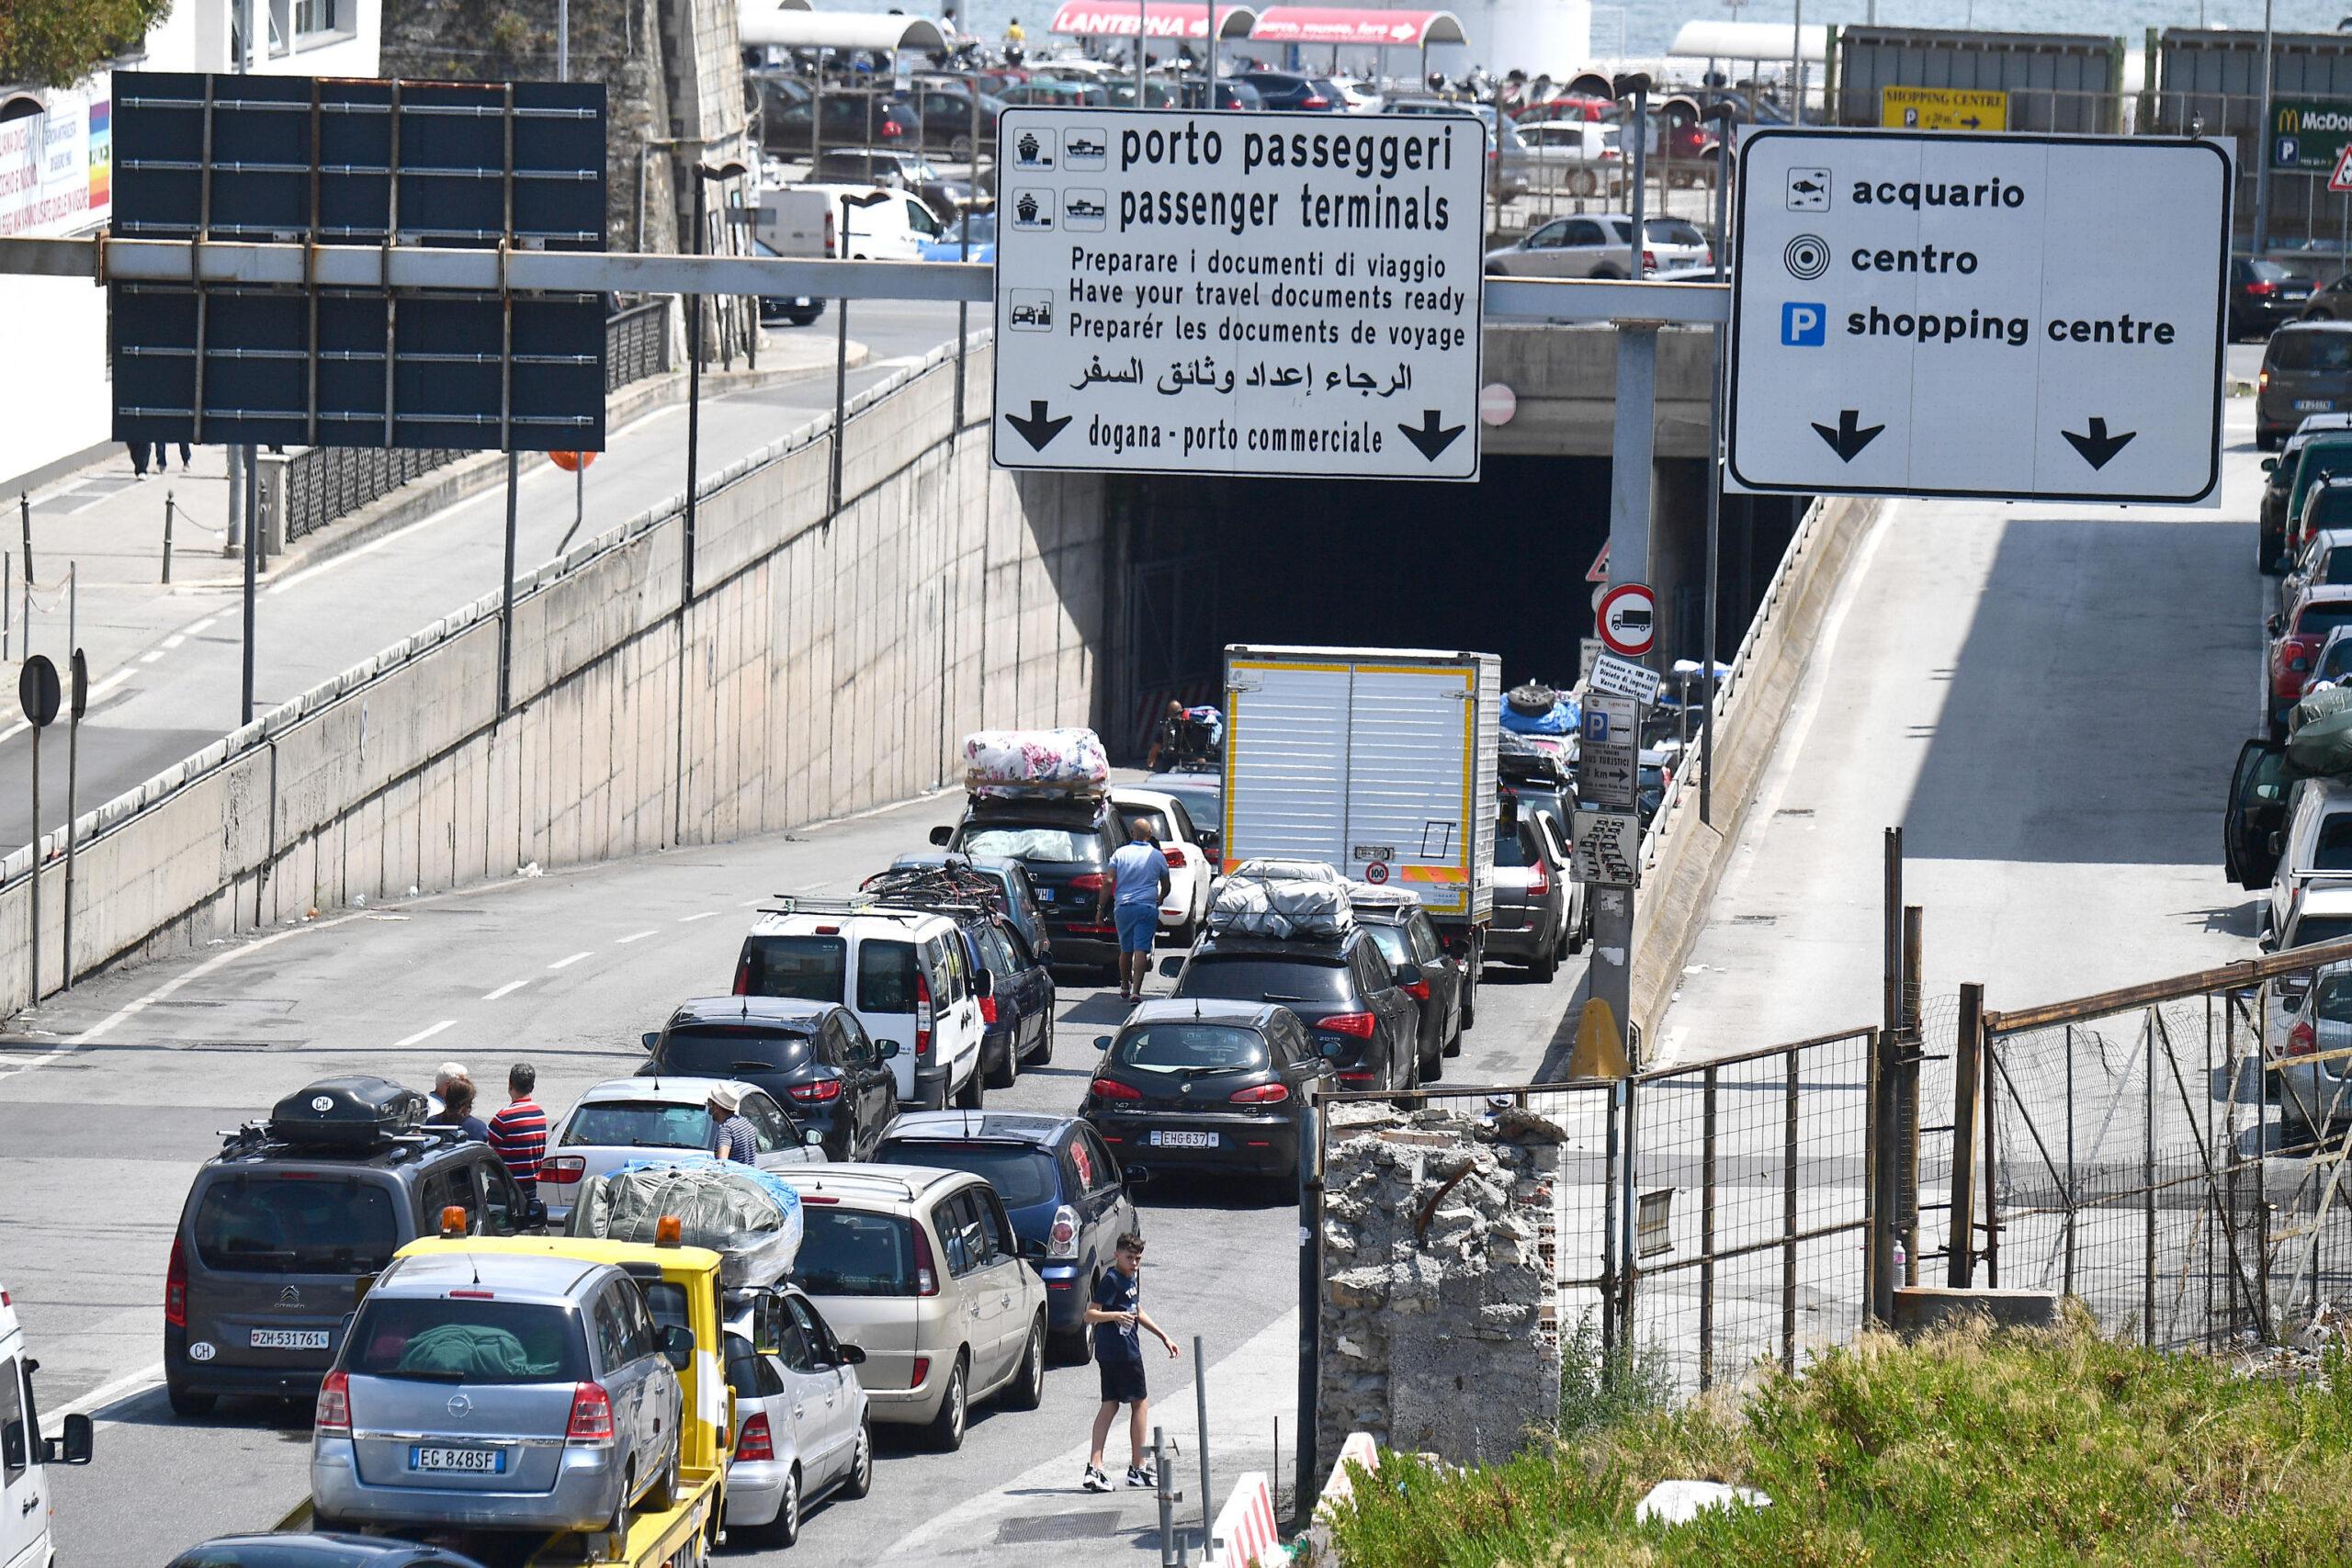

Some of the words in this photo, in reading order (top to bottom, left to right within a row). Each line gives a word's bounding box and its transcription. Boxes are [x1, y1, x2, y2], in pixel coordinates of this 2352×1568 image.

[1887, 90, 1949, 105] SHOPPING
[1954, 94, 2001, 107] CENTRE
[1122, 120, 1222, 172] porto
[1245, 125, 1452, 179] passeggeri
[1121, 191, 1278, 235] passenger
[1301, 183, 1448, 231] terminals
[1853, 177, 2024, 210] acquario
[1072, 247, 1177, 276] Preparare
[1192, 249, 1194, 273] i
[1208, 249, 1322, 276] documenti
[1336, 252, 1354, 276] di
[1368, 253, 1445, 283] viaggio
[1851, 244, 1977, 275] centro
[1070, 278, 1123, 303] Have
[1136, 286, 1182, 309] your
[1196, 281, 1259, 306] travel
[1272, 285, 1391, 309] documents
[1406, 289, 1464, 315] ready
[1070, 313, 1163, 343] Preparér
[1177, 317, 1206, 340] les
[1219, 319, 1339, 344] documents
[1351, 321, 1375, 344] de
[1389, 327, 1464, 351] voyage
[1791, 309, 1815, 341] P
[1847, 306, 2029, 346] shopping
[2048, 313, 2175, 344] centre
[1070, 355, 1143, 390] السفر
[1157, 355, 1234, 395] وثائق
[1247, 361, 1312, 396] إعداد
[1326, 362, 1411, 398] الرجاء
[1090, 414, 1160, 454] dogana
[1184, 419, 1238, 457] porto
[1249, 421, 1382, 453] commerciale
[1600, 668, 1620, 680] Divieto
[1630, 678, 1653, 691] ingresso
[1600, 678, 1617, 688] Varco
[1590, 715, 1604, 739] P
[1585, 755, 1596, 763] BUS
[1600, 756, 1629, 768] TURISTICI
[1594, 768, 1608, 778] km
[1371, 869, 1384, 878] 100
[316, 1099, 328, 1109] CH
[195, 1345, 209, 1358] CH
[421, 1450, 439, 1465] EG
[447, 1450, 493, 1468] 848SF
